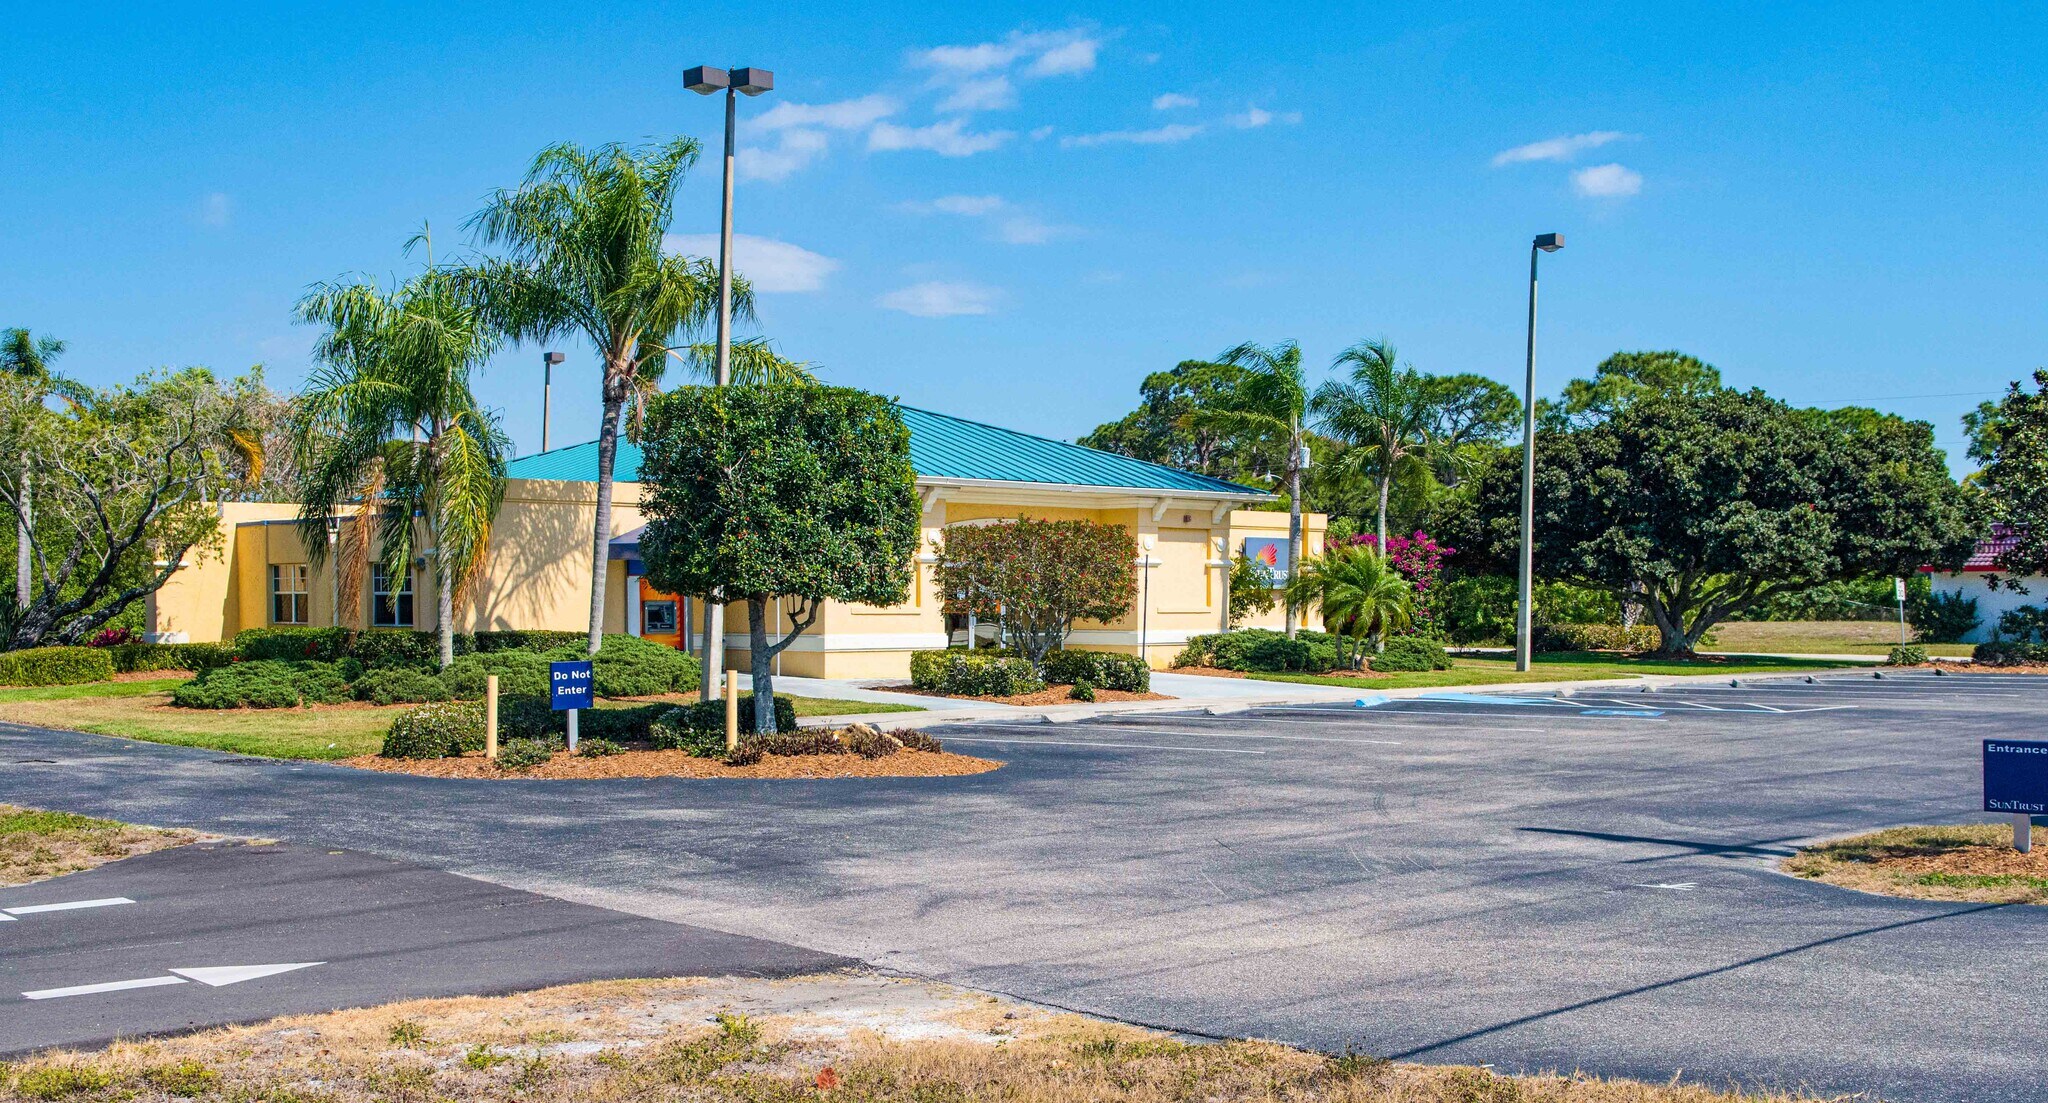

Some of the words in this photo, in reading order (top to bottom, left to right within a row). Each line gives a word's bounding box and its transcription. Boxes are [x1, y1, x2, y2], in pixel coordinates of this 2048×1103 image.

[554, 671, 568, 681] Do
[571, 670, 591, 679] Not
[557, 686, 587, 695] Enter
[1987, 743, 2048, 754] Entrance
